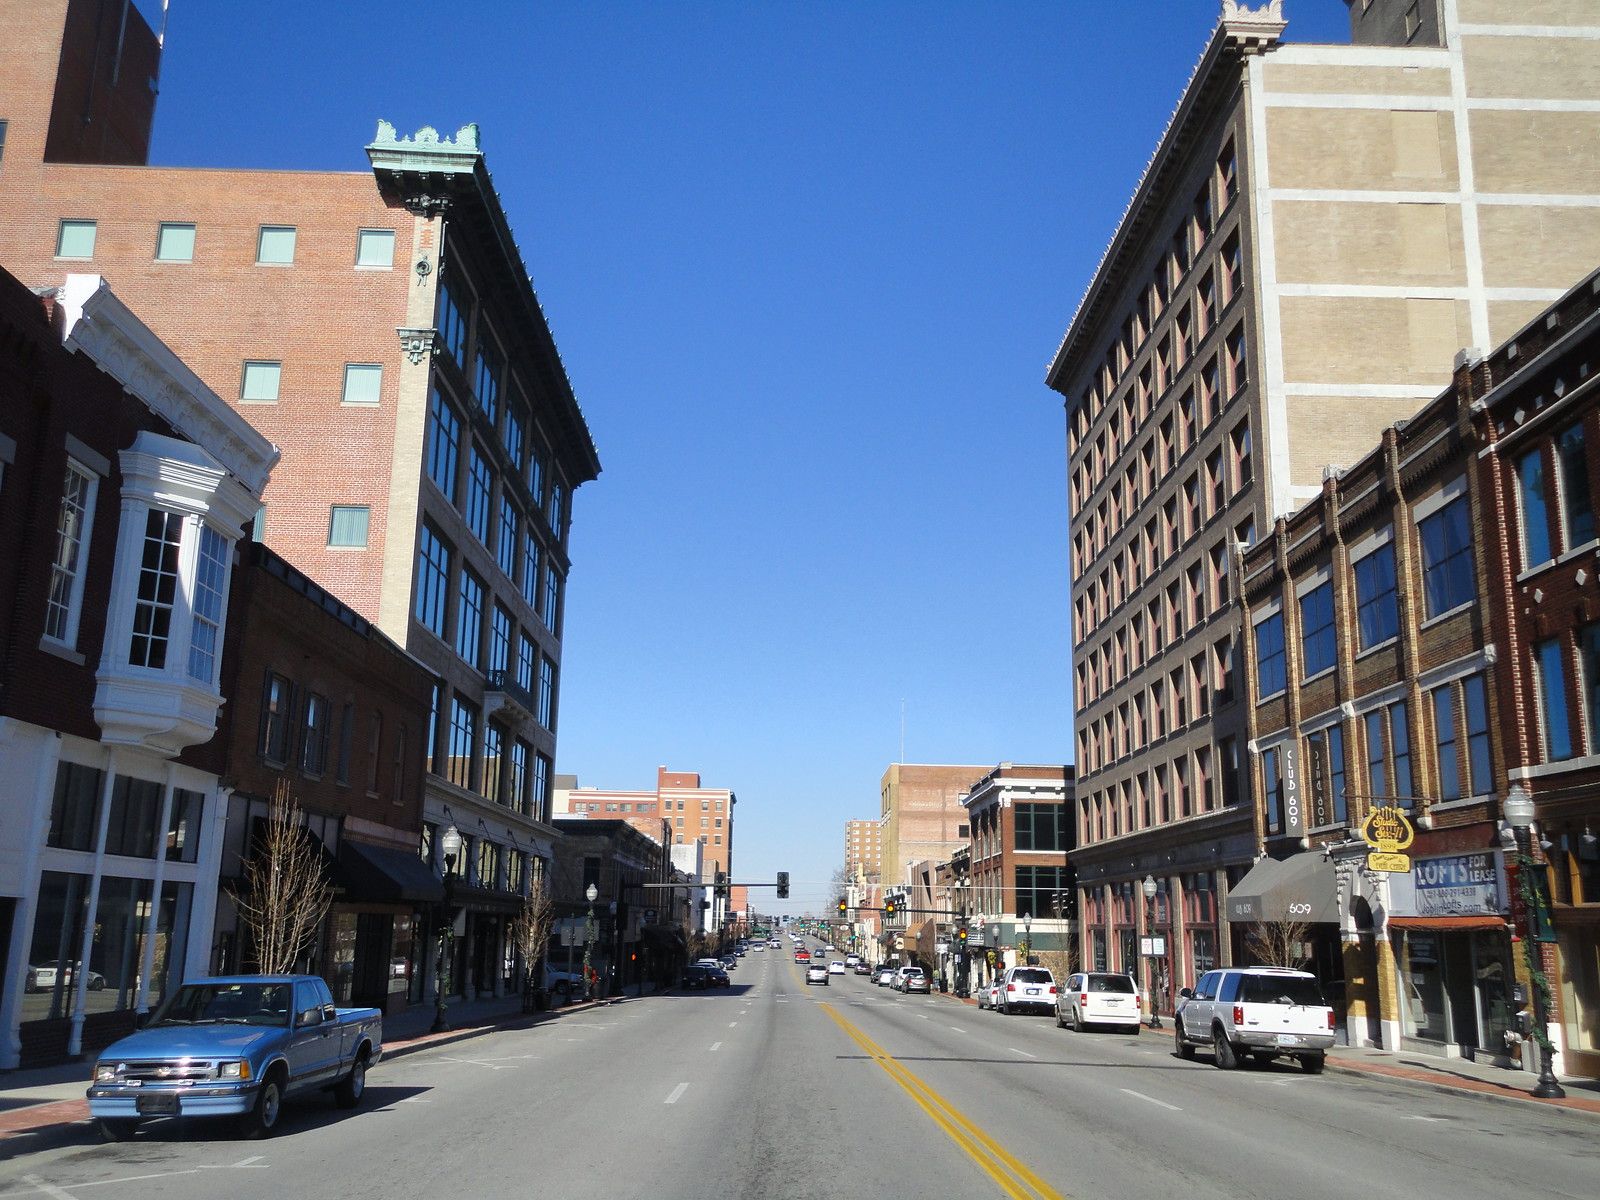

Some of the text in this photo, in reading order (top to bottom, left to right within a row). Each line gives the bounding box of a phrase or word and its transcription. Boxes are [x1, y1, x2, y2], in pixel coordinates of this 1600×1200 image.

[1287, 750, 1298, 826] CLUB 609
[1372, 815, 1398, 828] Studio
[1469, 855, 1486, 867] FOR
[1416, 858, 1468, 886] LOFTS
[1469, 869, 1496, 883] LEASE
[1289, 903, 1311, 914] 609
